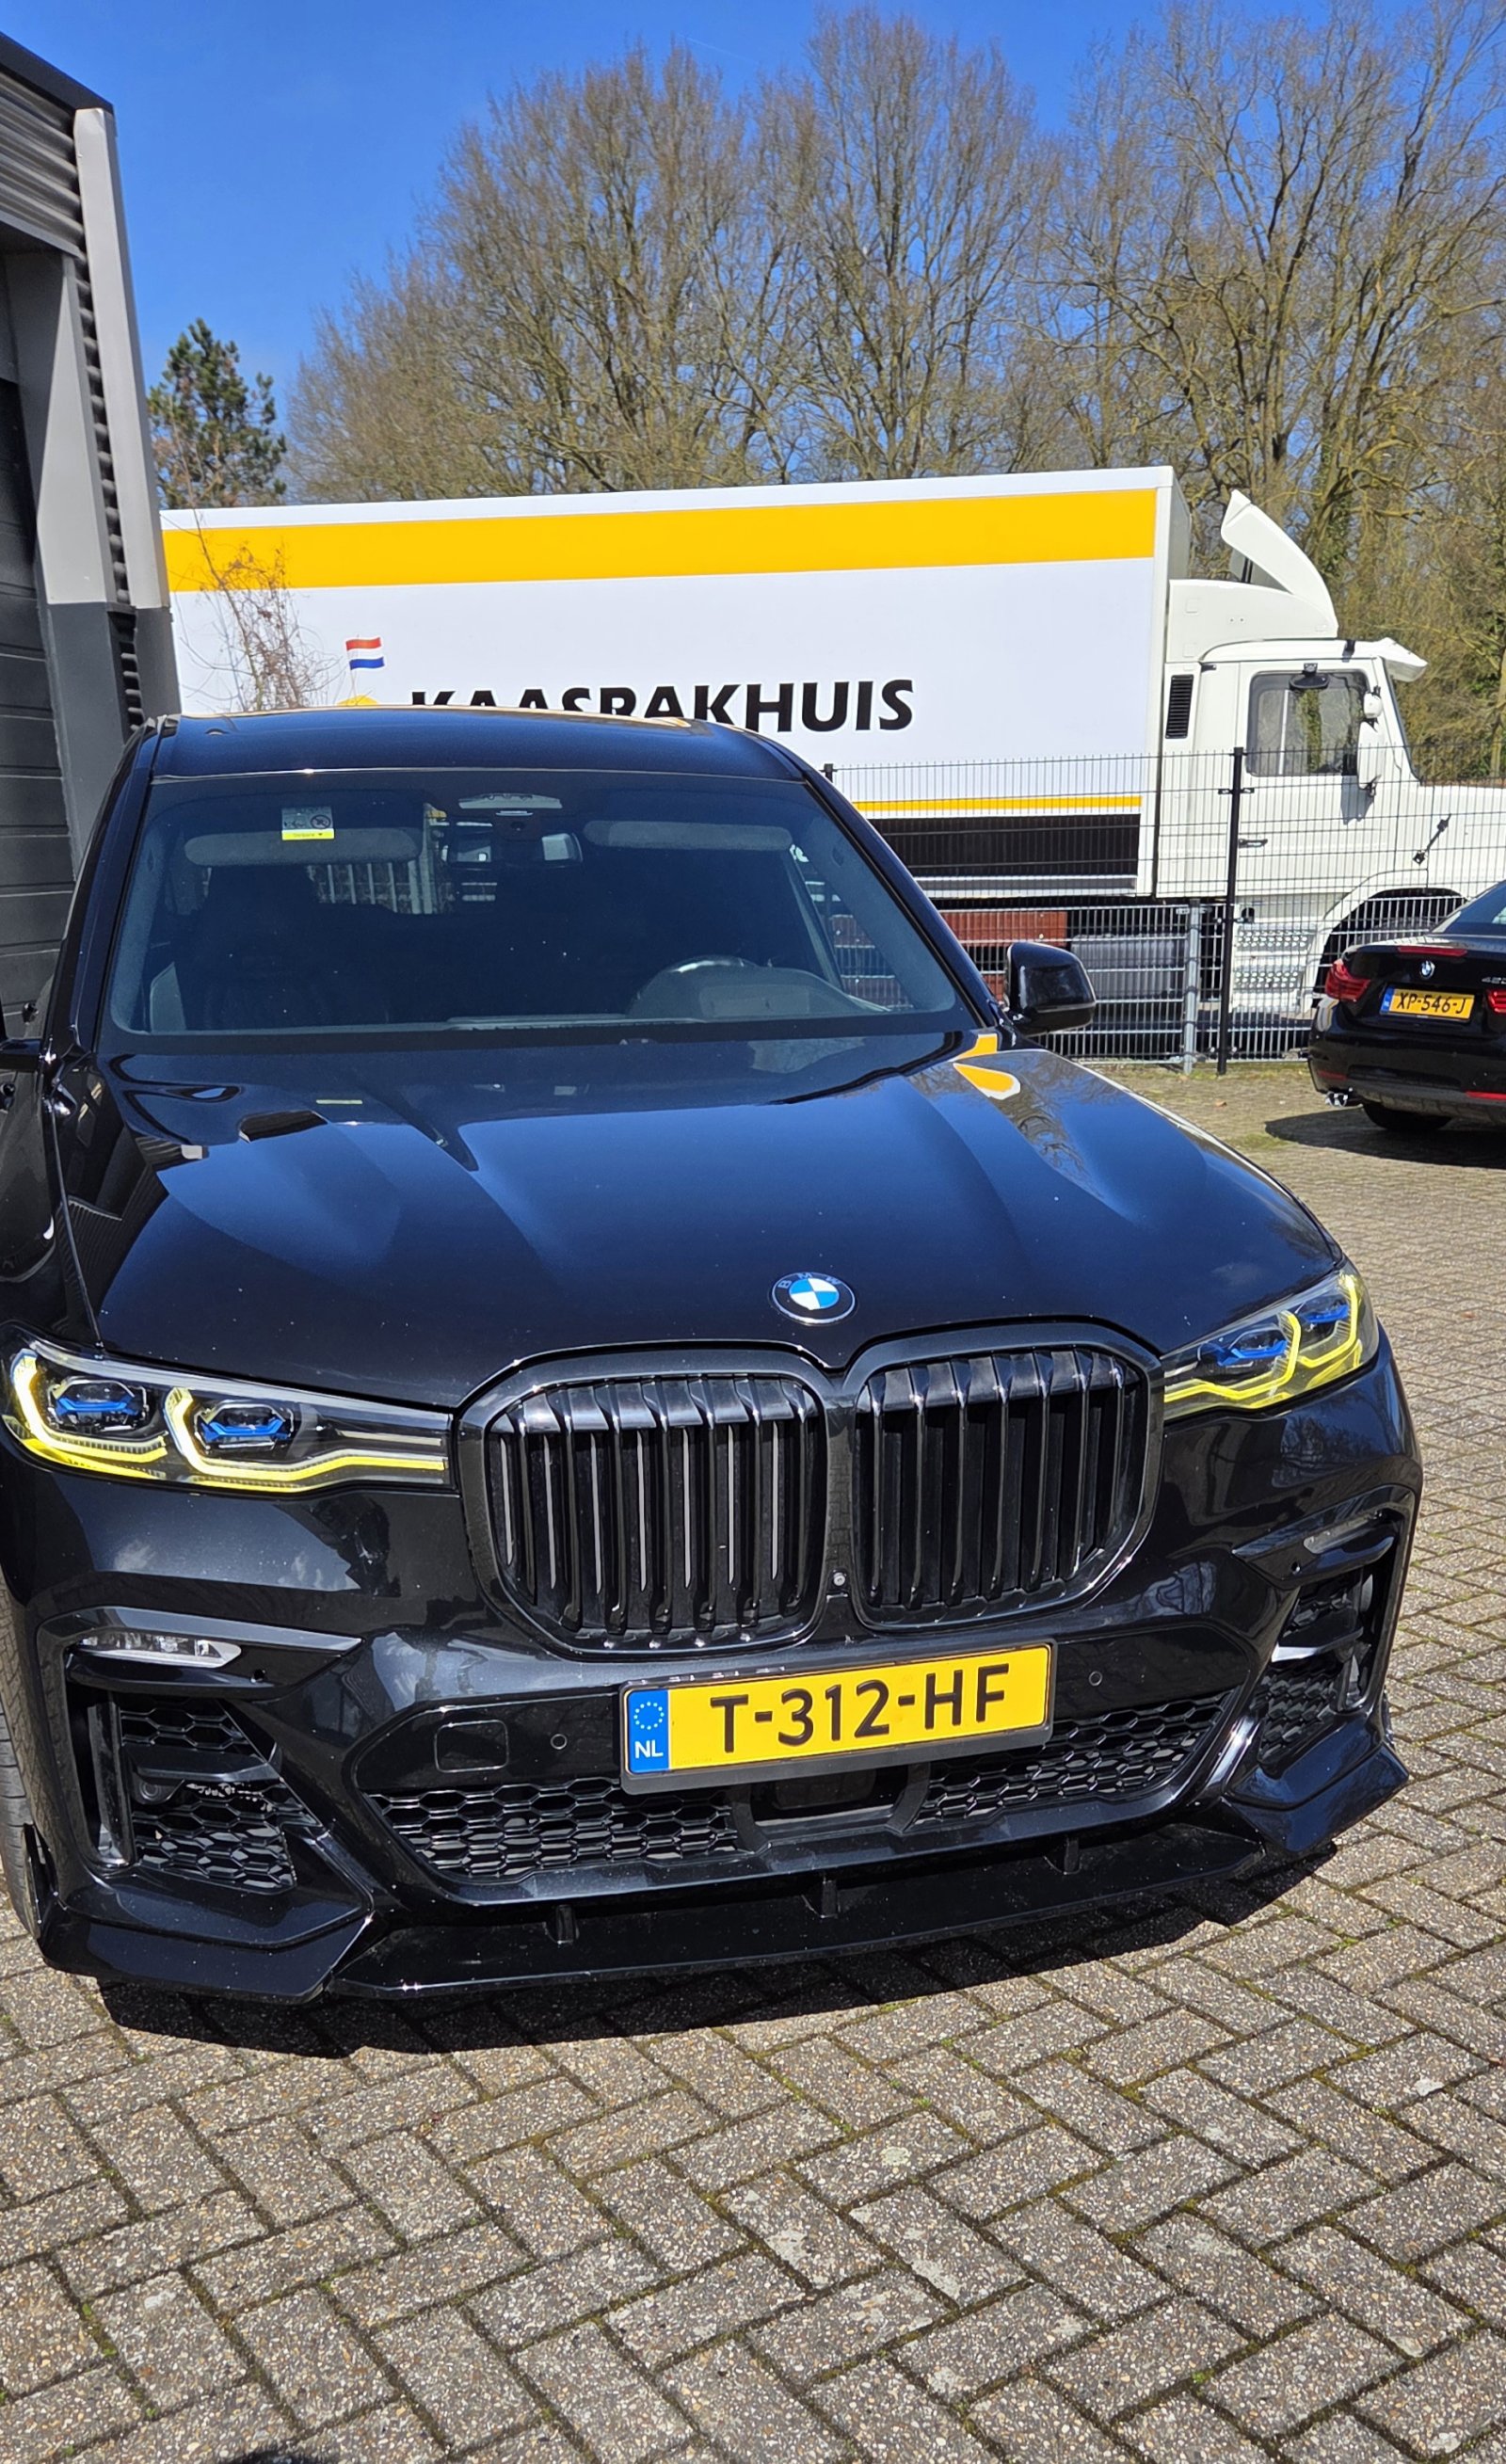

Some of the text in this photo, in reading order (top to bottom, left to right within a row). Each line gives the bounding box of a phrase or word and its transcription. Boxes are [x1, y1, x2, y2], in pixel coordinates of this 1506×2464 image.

[412, 679, 914, 732] PAKHUIS
[1396, 991, 1466, 1015] XP-546-J
[777, 1272, 842, 1289] BMW
[710, 1662, 1010, 1753] T-312-HF
[634, 1739, 664, 1759] NL
